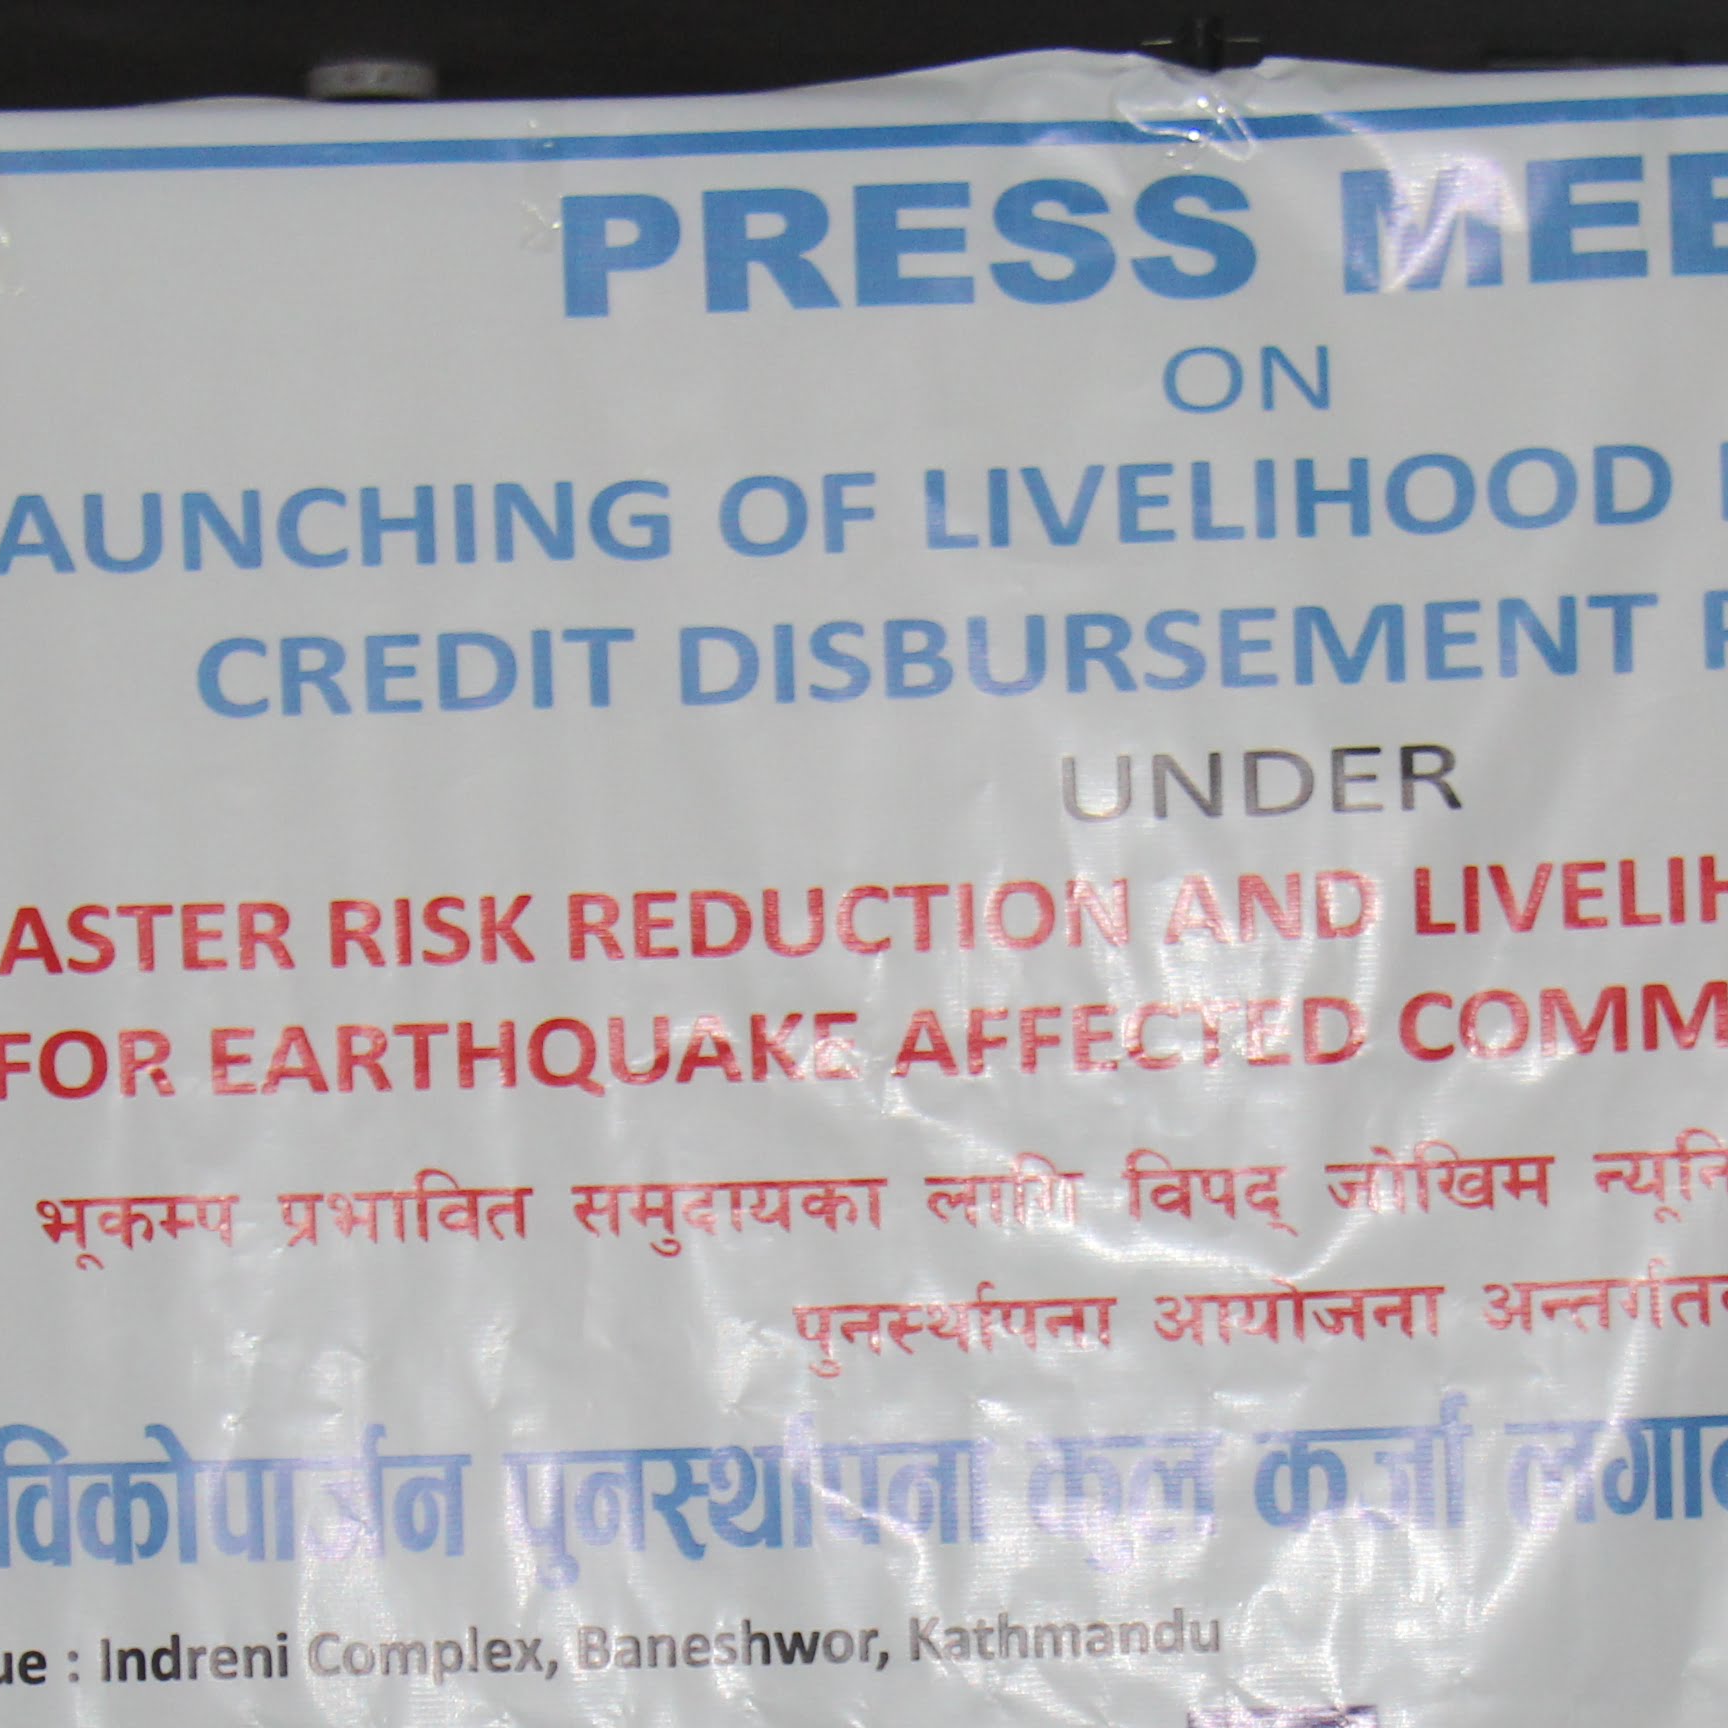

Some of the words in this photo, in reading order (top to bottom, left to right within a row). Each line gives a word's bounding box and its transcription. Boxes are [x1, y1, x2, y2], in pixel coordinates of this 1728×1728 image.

[559, 174, 1258, 318] PRESS
[1162, 344, 1333, 415] ON
[719, 470, 876, 558] OF
[924, 442, 1673, 548] LIVELIHOOD
[197, 626, 634, 720] CREDIT
[679, 593, 1657, 708] DISBURSEMENT
[1062, 744, 1460, 820] UNDER
[329, 894, 535, 968] RISK
[569, 877, 1130, 963] REDUCTION
[1167, 870, 1379, 945] AND
[211, 1012, 860, 1098] EARTHQUAKE
[891, 996, 1367, 1078] AFFECTED
[35, 1194, 240, 1271] भूकम्प
[277, 1168, 533, 1247] प्रभावित
[571, 1177, 888, 1257] समुदायका
[924, 1152, 1083, 1229] लागि
[1121, 1148, 1299, 1236] विपद्
[1325, 1140, 1555, 1213] जोखिम
[1154, 1275, 1446, 1344] आयोजना
[100, 1632, 290, 1684] Indreni
[306, 1627, 561, 1683] Complex,
[577, 1619, 889, 1672] Baneshwor,
[909, 1608, 1221, 1660] Kathmandu
